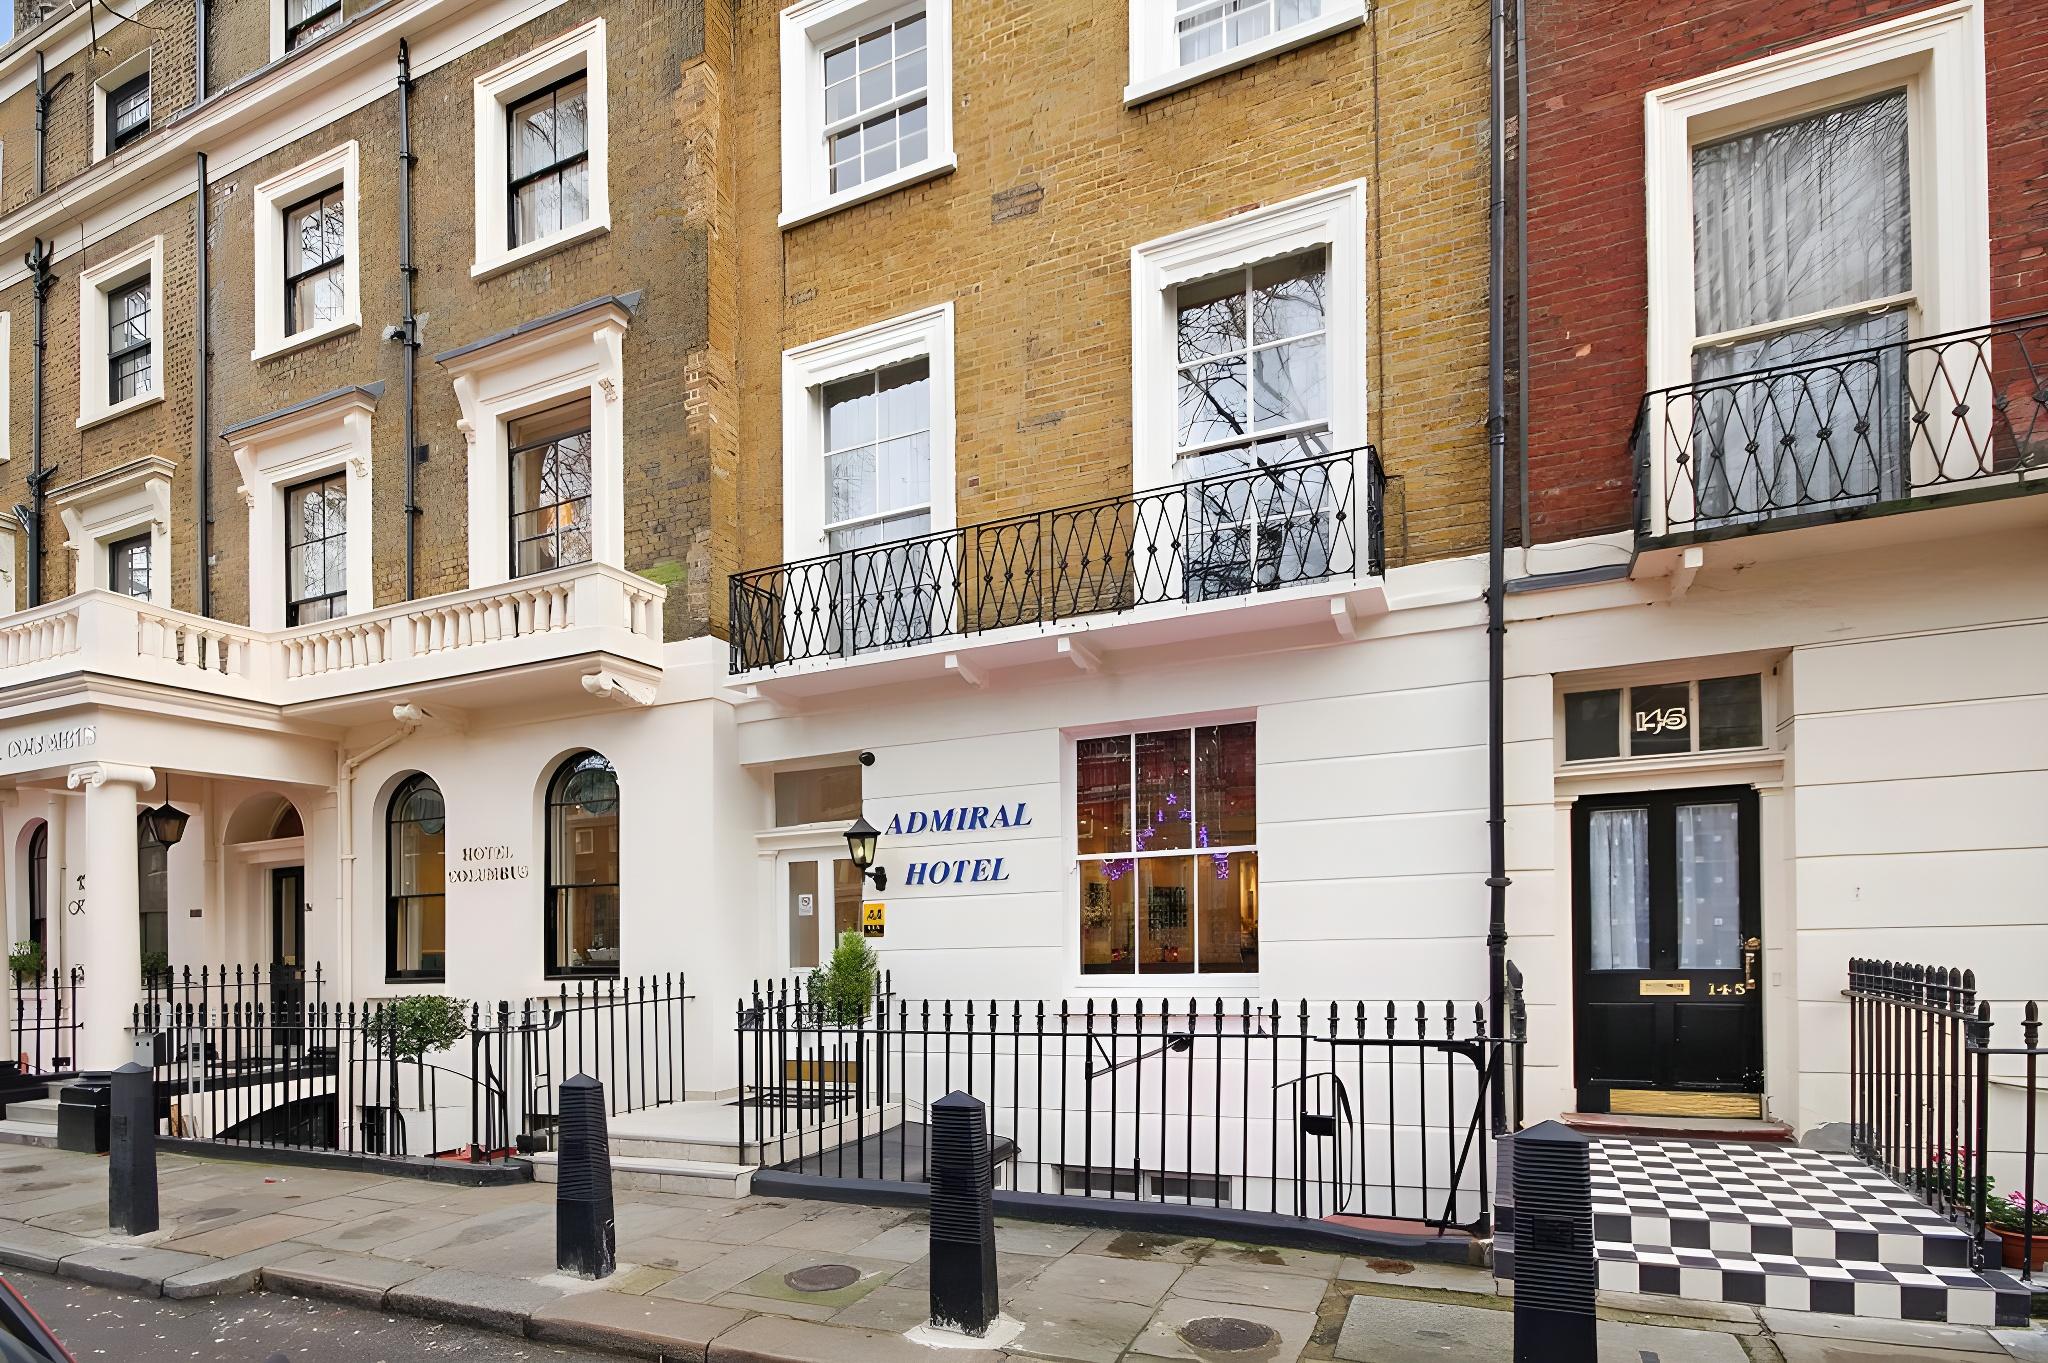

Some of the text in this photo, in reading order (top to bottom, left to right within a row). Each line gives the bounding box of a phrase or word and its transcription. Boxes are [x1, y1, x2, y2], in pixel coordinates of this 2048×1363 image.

[885, 803, 1033, 835] ADMIRAL
[462, 845, 514, 861] HOTEL
[905, 857, 1010, 885] HOTEL
[1708, 983, 1746, 996] 145
